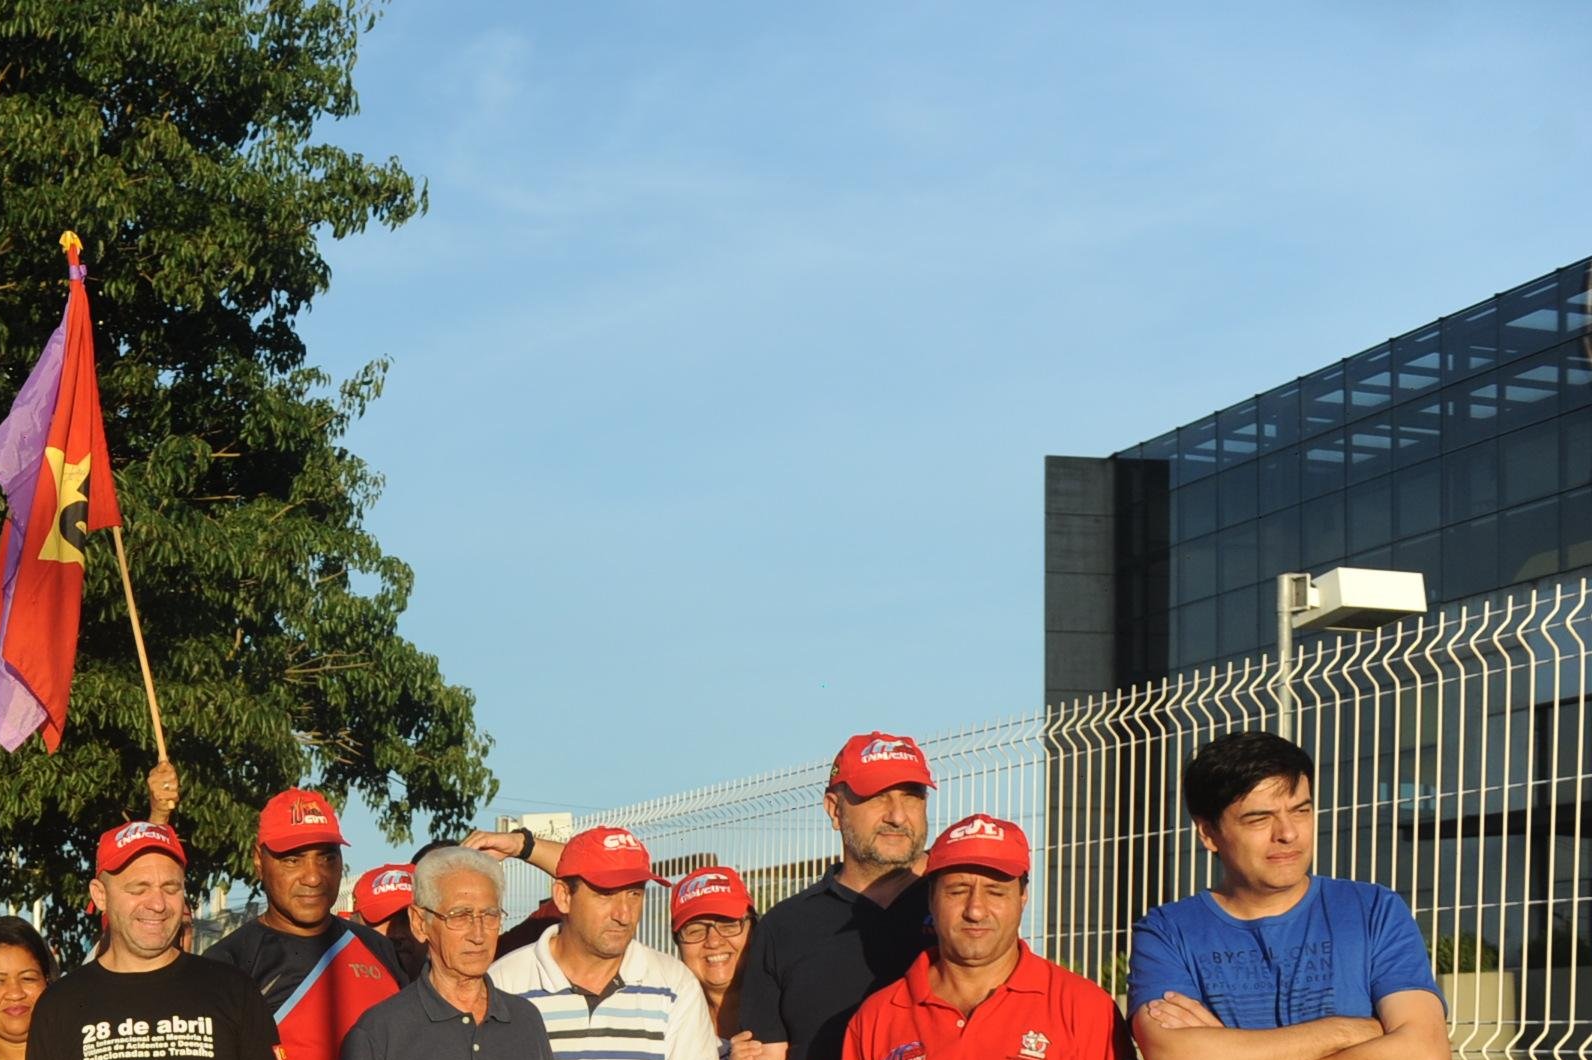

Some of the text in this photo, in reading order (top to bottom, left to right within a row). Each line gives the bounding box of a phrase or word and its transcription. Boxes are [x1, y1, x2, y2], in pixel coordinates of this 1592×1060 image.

[81, 1015, 213, 1044] 28 de abril
[96, 1036, 150, 1048] Internacional
[126, 1041, 168, 1050] Acidentes
[152, 1050, 166, 1058] ao
[168, 1047, 214, 1059] Trabalho
